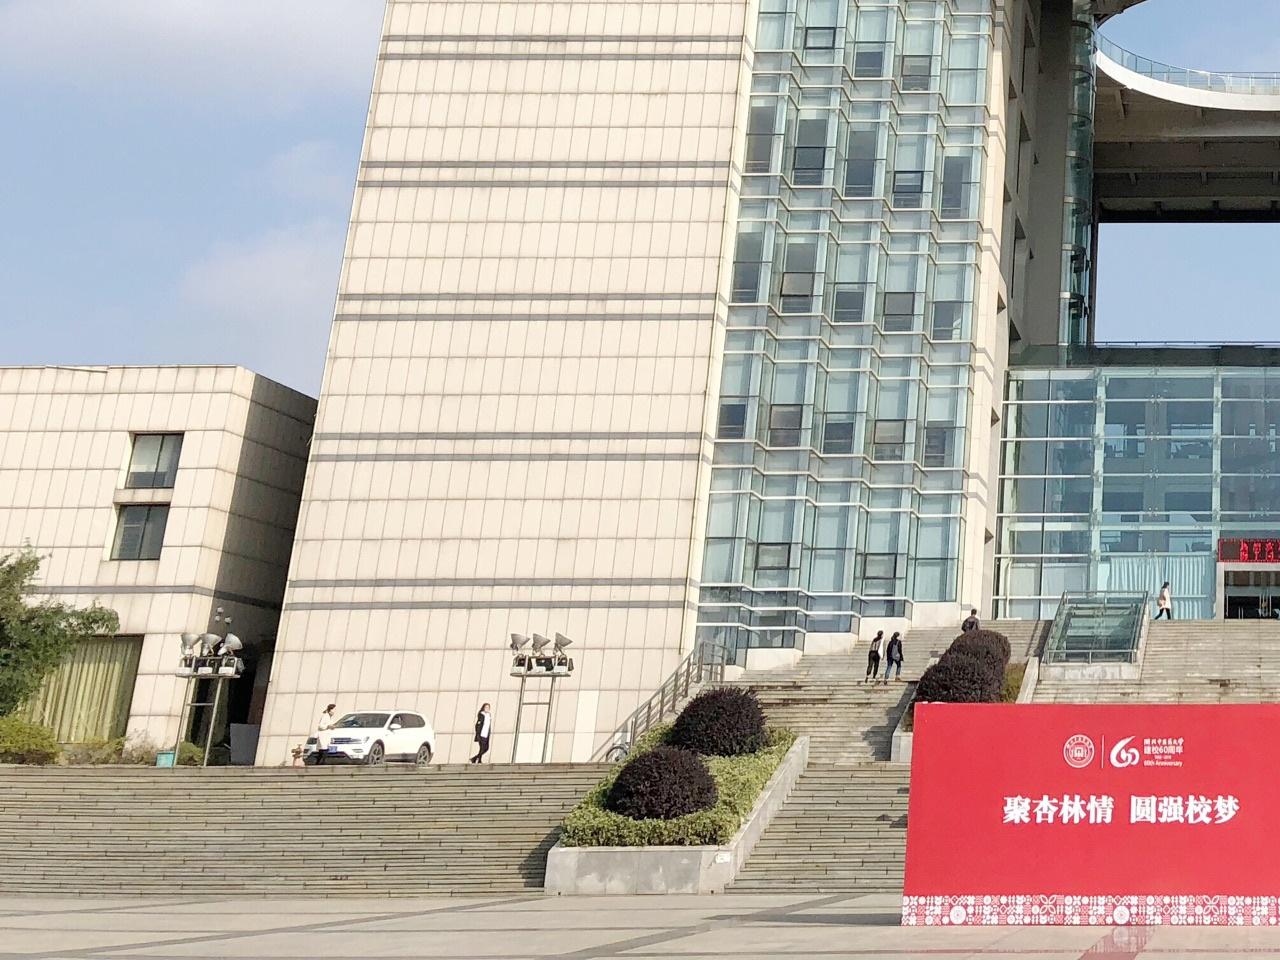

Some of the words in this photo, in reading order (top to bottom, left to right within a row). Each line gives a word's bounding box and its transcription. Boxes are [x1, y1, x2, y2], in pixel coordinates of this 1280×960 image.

[1002, 794, 1115, 824] 聚杏林情
[1130, 794, 1240, 825] 圆强校梦
